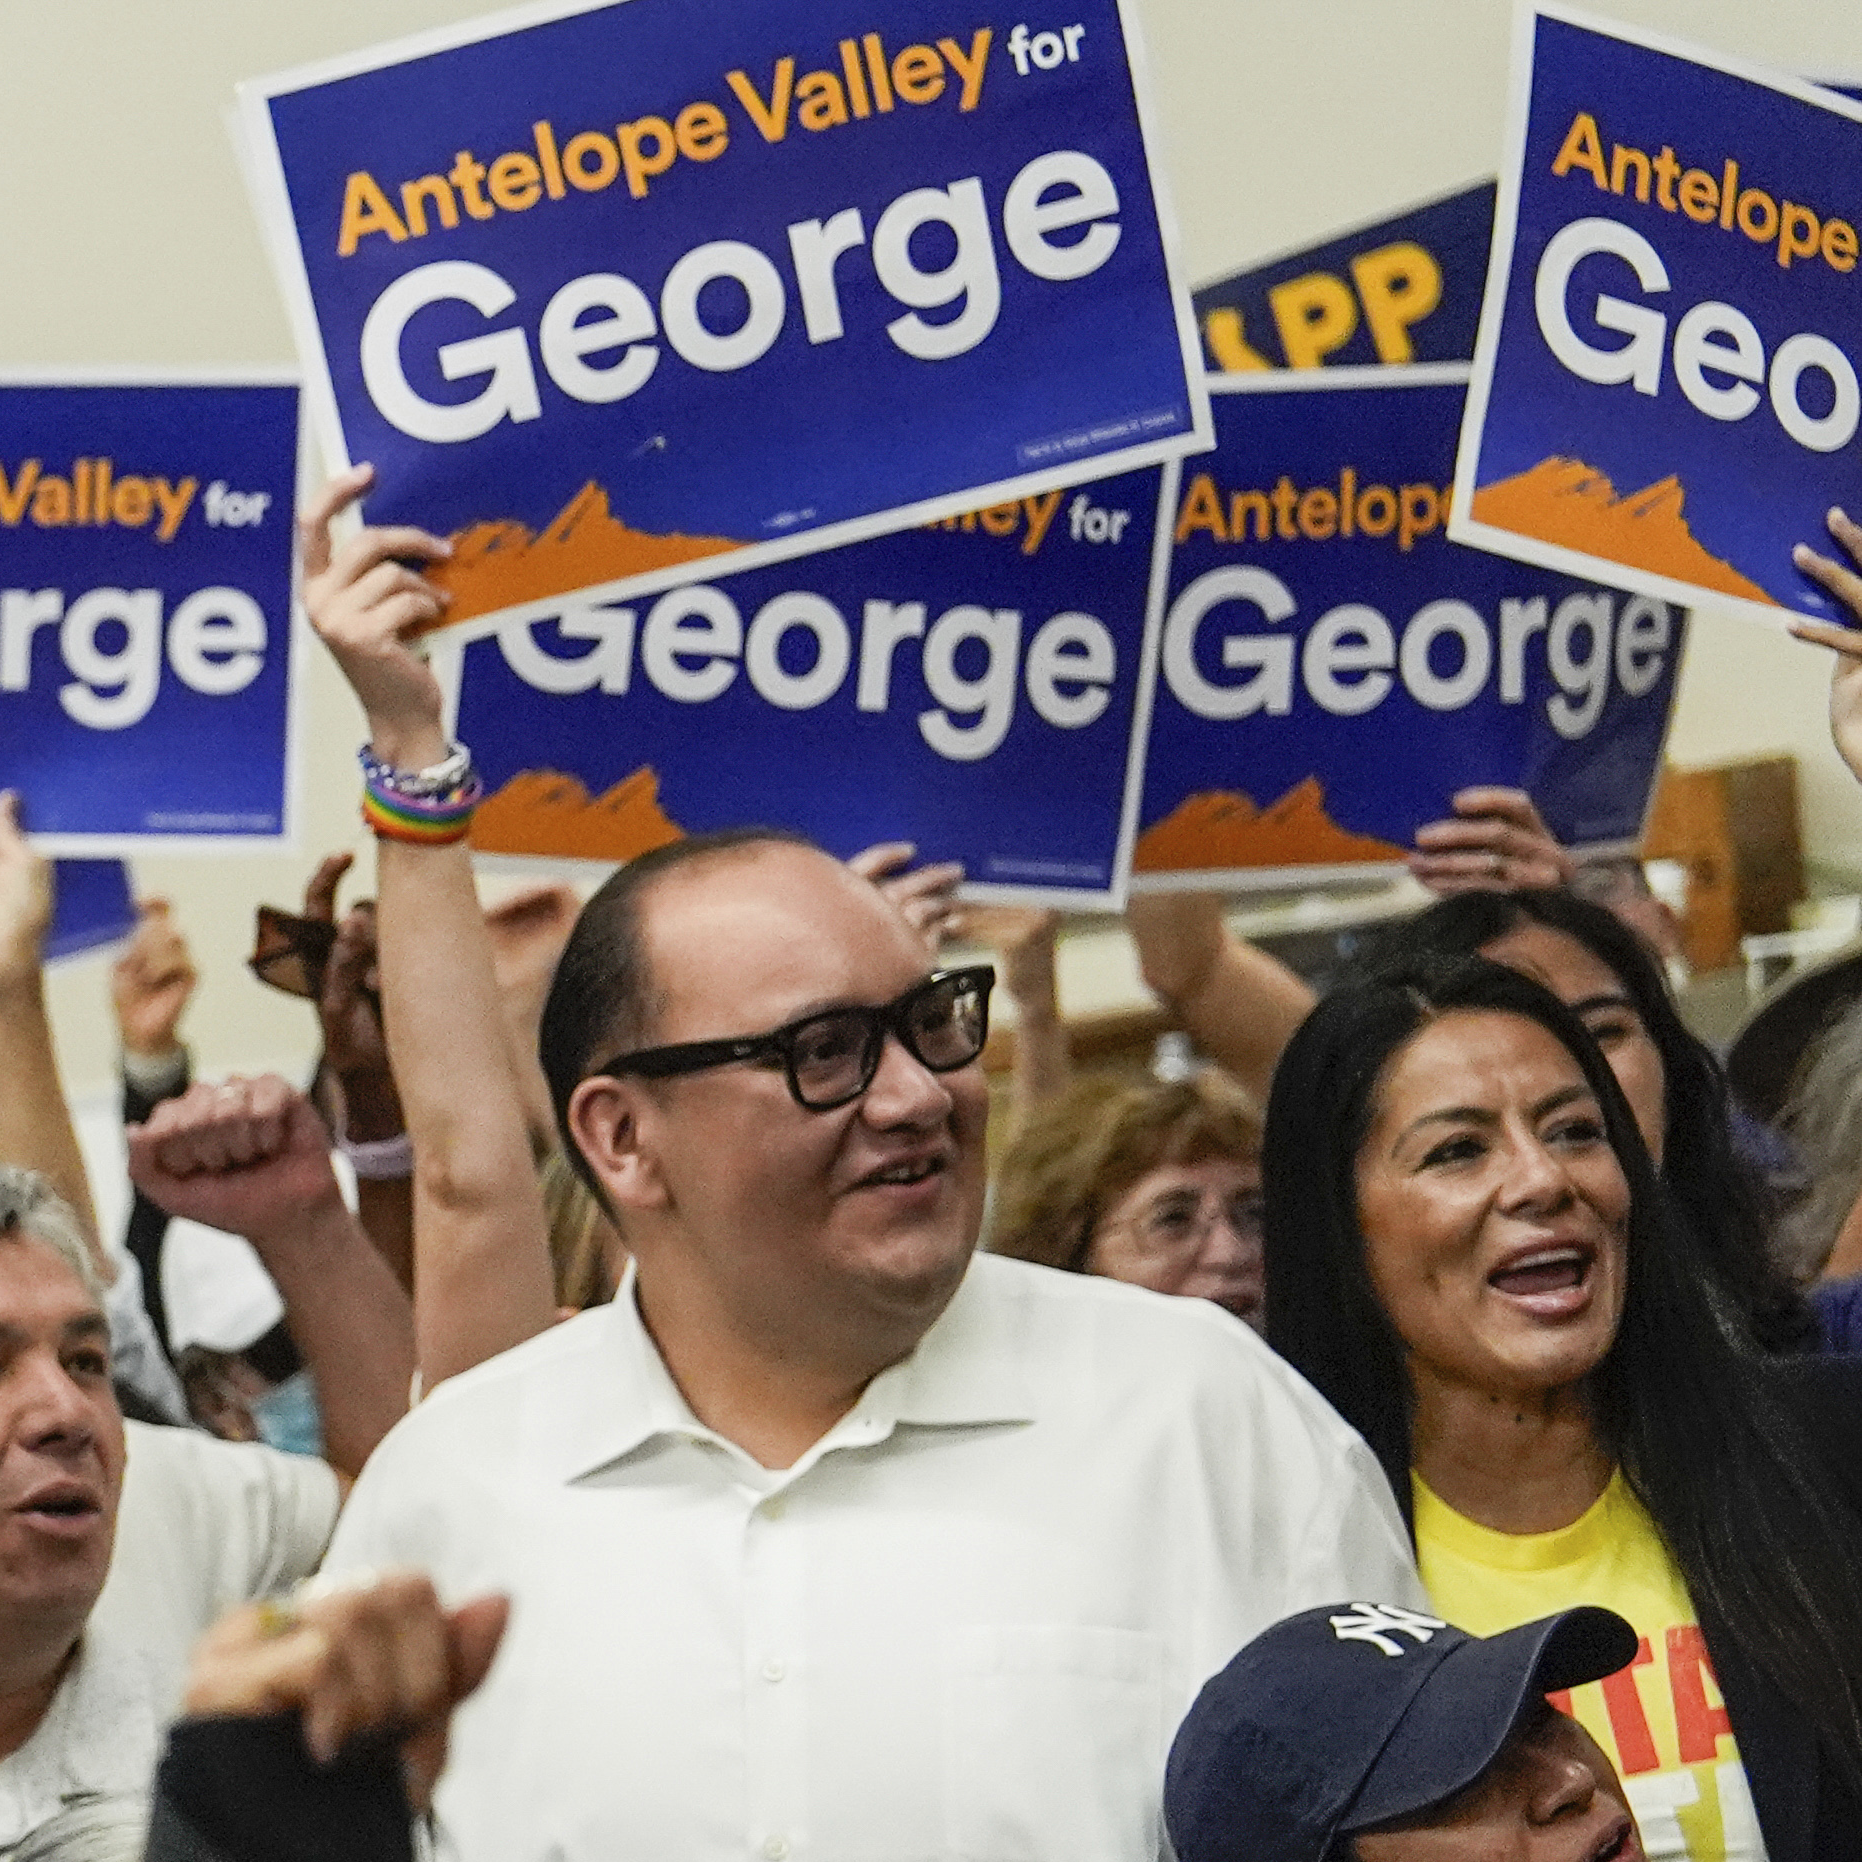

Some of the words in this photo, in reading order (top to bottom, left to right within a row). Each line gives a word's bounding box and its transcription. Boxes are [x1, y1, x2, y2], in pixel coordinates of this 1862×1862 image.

[335, 99, 730, 258] Antelope
[726, 27, 996, 146] Valley
[1007, 20, 1087, 77] for
[1550, 110, 1859, 273] Antelope
[360, 149, 1123, 444] George
[201, 480, 271, 527] for
[1067, 493, 1132, 545] for
[495, 585, 1118, 761] George
[1161, 563, 1672, 740] George
[1329, 1602, 1446, 1656] NY
